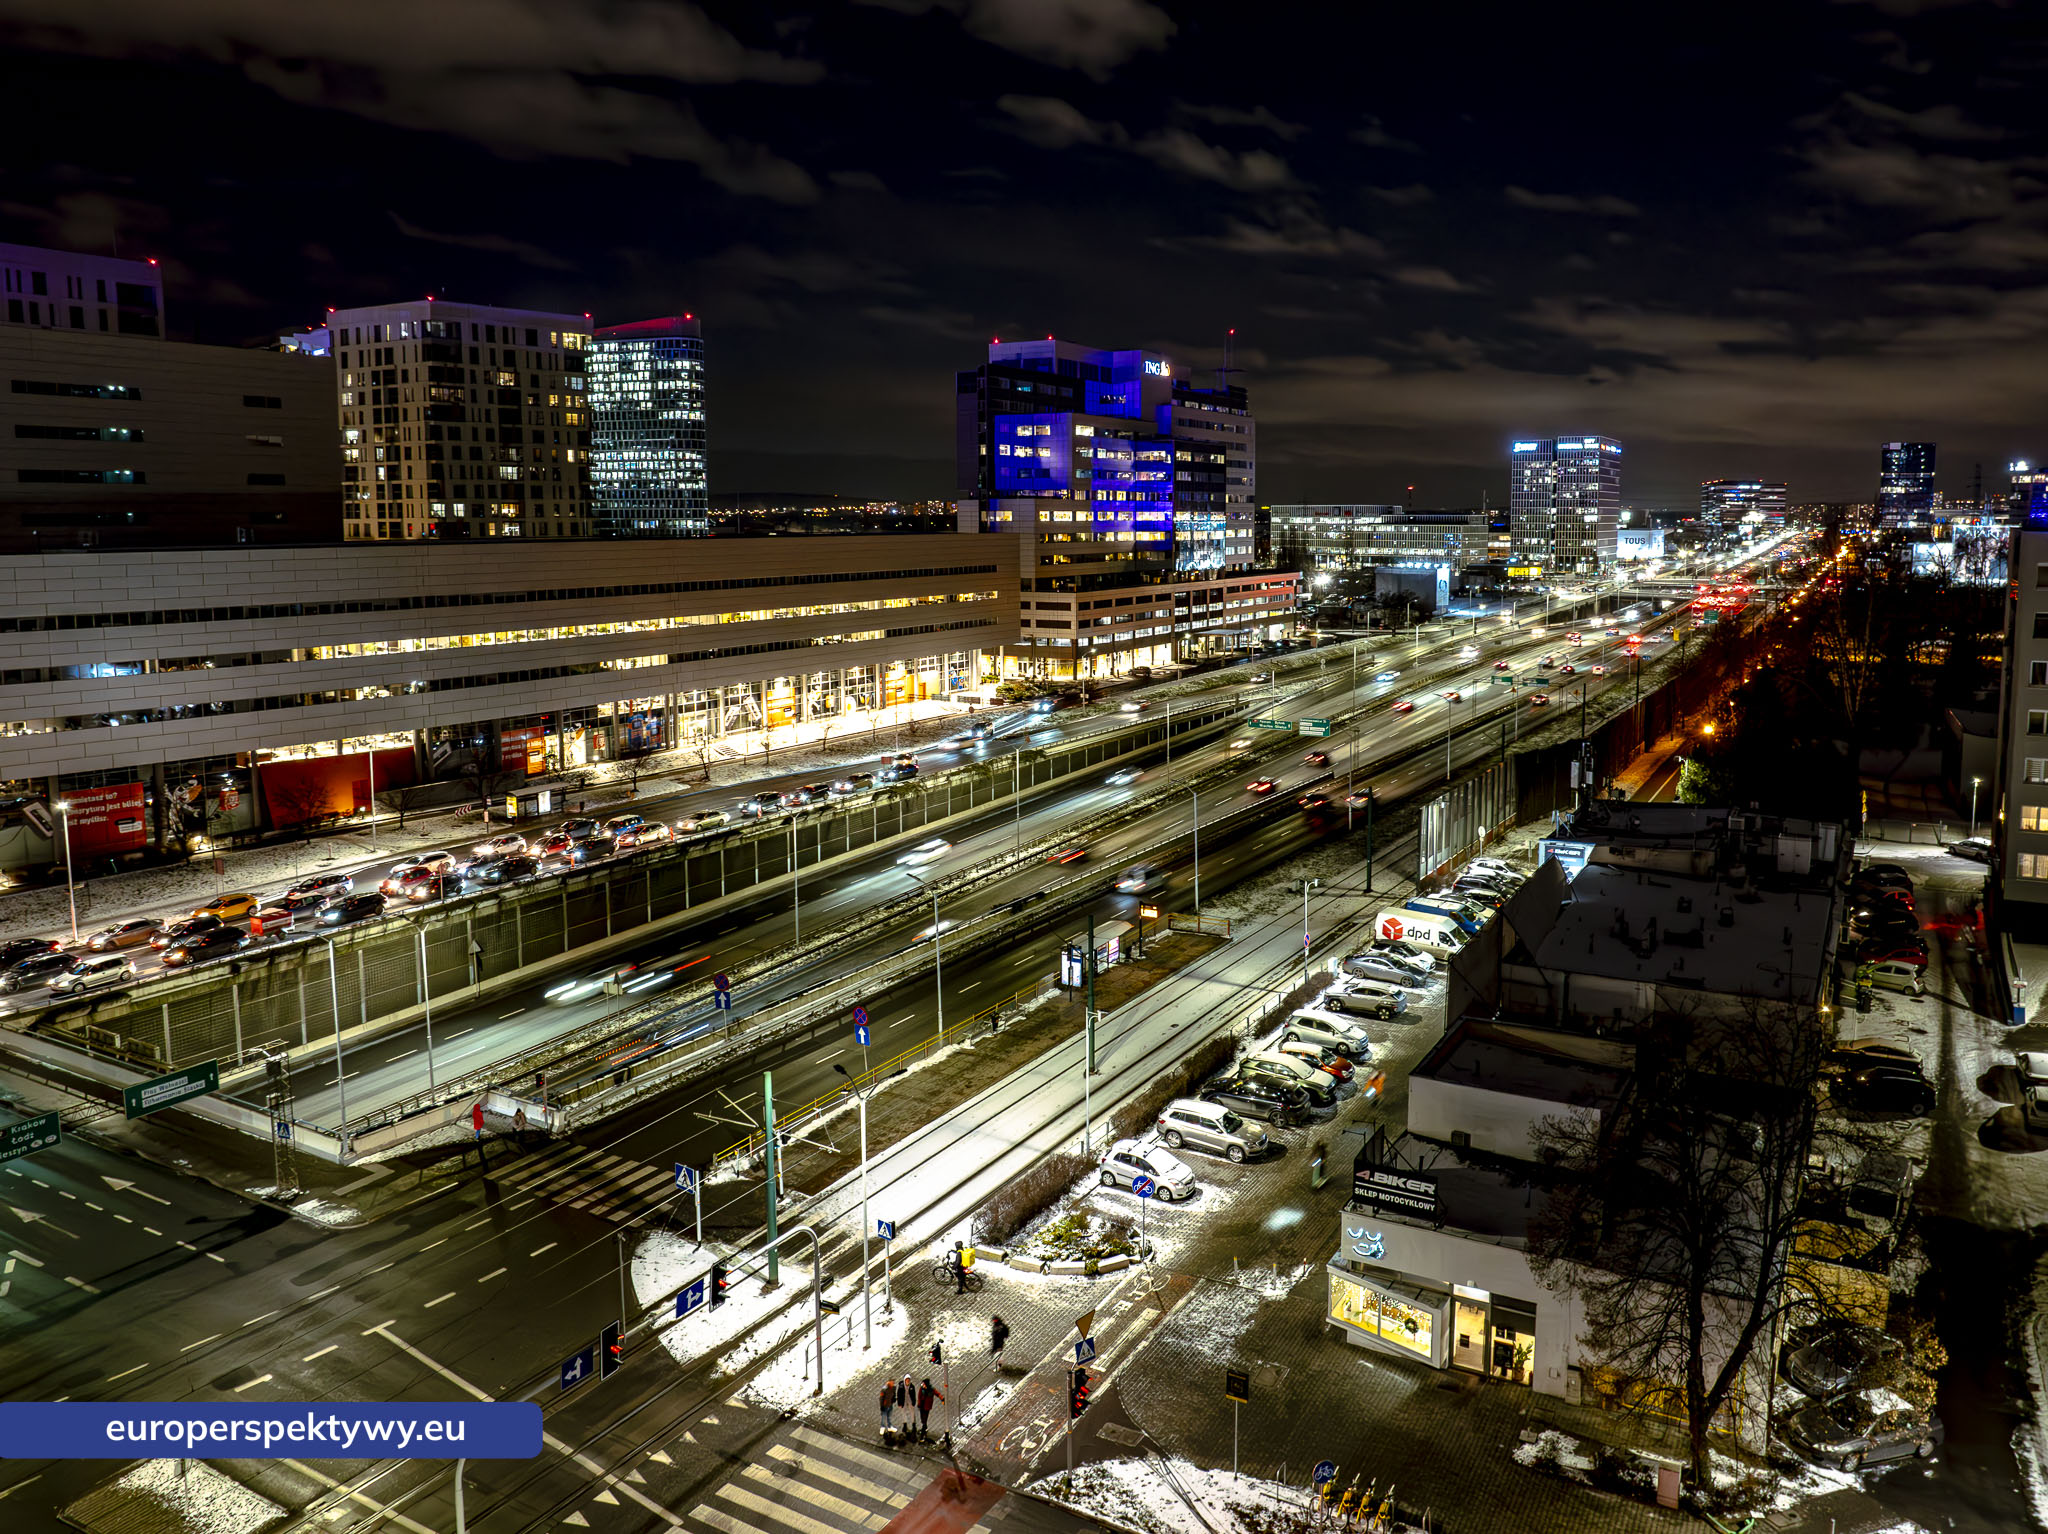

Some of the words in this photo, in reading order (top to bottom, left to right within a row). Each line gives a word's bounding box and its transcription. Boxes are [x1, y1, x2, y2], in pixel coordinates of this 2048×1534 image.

[1145, 360, 1160, 376] ING
[1624, 537, 1646, 545] TOUS
[1407, 926, 1431, 941] dpd
[1354, 1187, 1378, 1198] SKLEP
[1378, 1192, 1435, 1211] MOTOCYKLOWY
